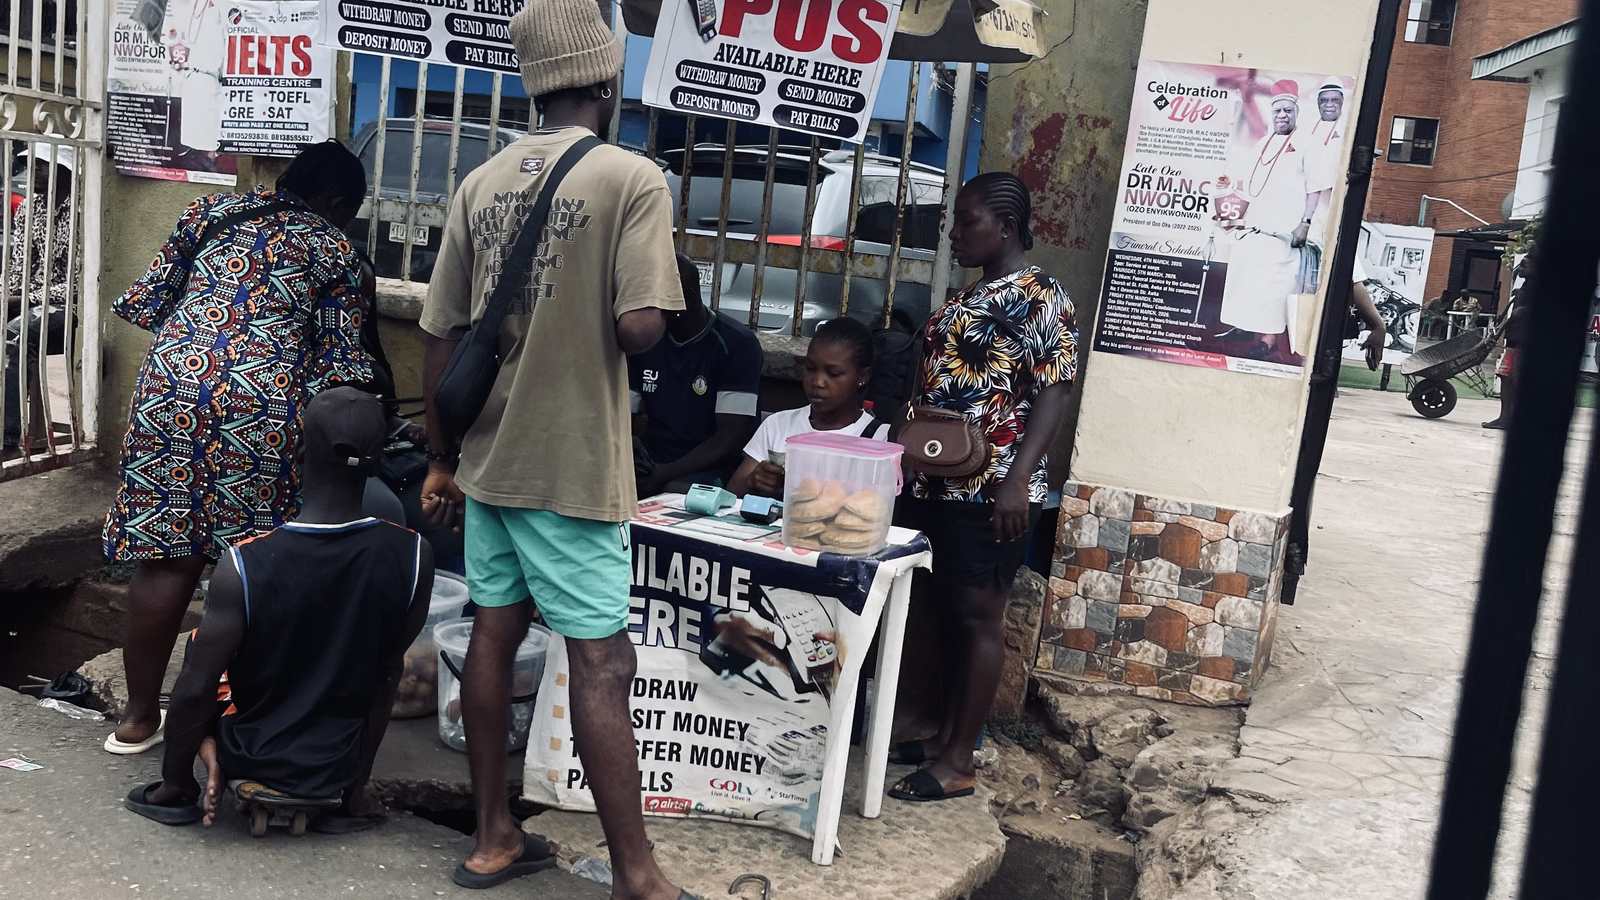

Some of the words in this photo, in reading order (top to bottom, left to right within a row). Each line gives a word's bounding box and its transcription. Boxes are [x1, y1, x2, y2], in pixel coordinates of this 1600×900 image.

[341, 3, 392, 23] WITHDRAW
[393, 10, 426, 28] MONEY
[114, 31, 129, 43] DR
[453, 18, 483, 35] SEND
[485, 22, 511, 40] MON
[718, 0, 889, 64] POS
[113, 43, 166, 59] NWOFOR
[344, 31, 390, 50] DEPOSIT
[390, 37, 428, 55] MONEY
[226, 34, 313, 77] IELTS
[464, 46, 485, 63] PAY
[487, 50, 520, 69] BILLS
[713, 42, 808, 78] AVAILABLE
[811, 61, 863, 89] HERE
[226, 78, 270, 87] TRAINING
[271, 79, 312, 87] CENTRE
[679, 64, 727, 87] WITHDRAW
[727, 73, 762, 92] MONEY
[229, 90, 253, 103] PTE
[268, 91, 311, 104] TOEFL
[785, 83, 814, 101] SEND
[816, 89, 856, 109] MONEY
[1147, 80, 1229, 100] Celebration
[228, 107, 254, 119] GRE
[267, 106, 293, 119] SAT
[676, 91, 719, 111] DEPOSIT
[720, 98, 756, 118] MONEY
[1167, 95, 1218, 122] Life
[790, 110, 811, 127] PAY
[812, 114, 841, 132] BILLS
[1132, 163, 1157, 174] Late
[1160, 166, 1182, 176] Ozo
[1127, 172, 1152, 189] DR
[1156, 175, 1211, 195] M.N.C
[1124, 188, 1209, 212] NWOFOR
[1126, 204, 1145, 214] (OZO
[1146, 206, 1201, 219] ENYIKWONWA)
[1220, 201, 1241, 220] 95
[1116, 235, 1159, 251] Funeral
[642, 369, 659, 381] SU
[629, 543, 752, 613] ILABLE
[628, 596, 702, 656] ERE
[633, 677, 699, 702] DRAW
[631, 708, 666, 731] SIT
[673, 711, 750, 742] MONEY
[689, 744, 767, 775] MONEY
[567, 769, 592, 790] PA
[660, 799, 688, 810] airtel
